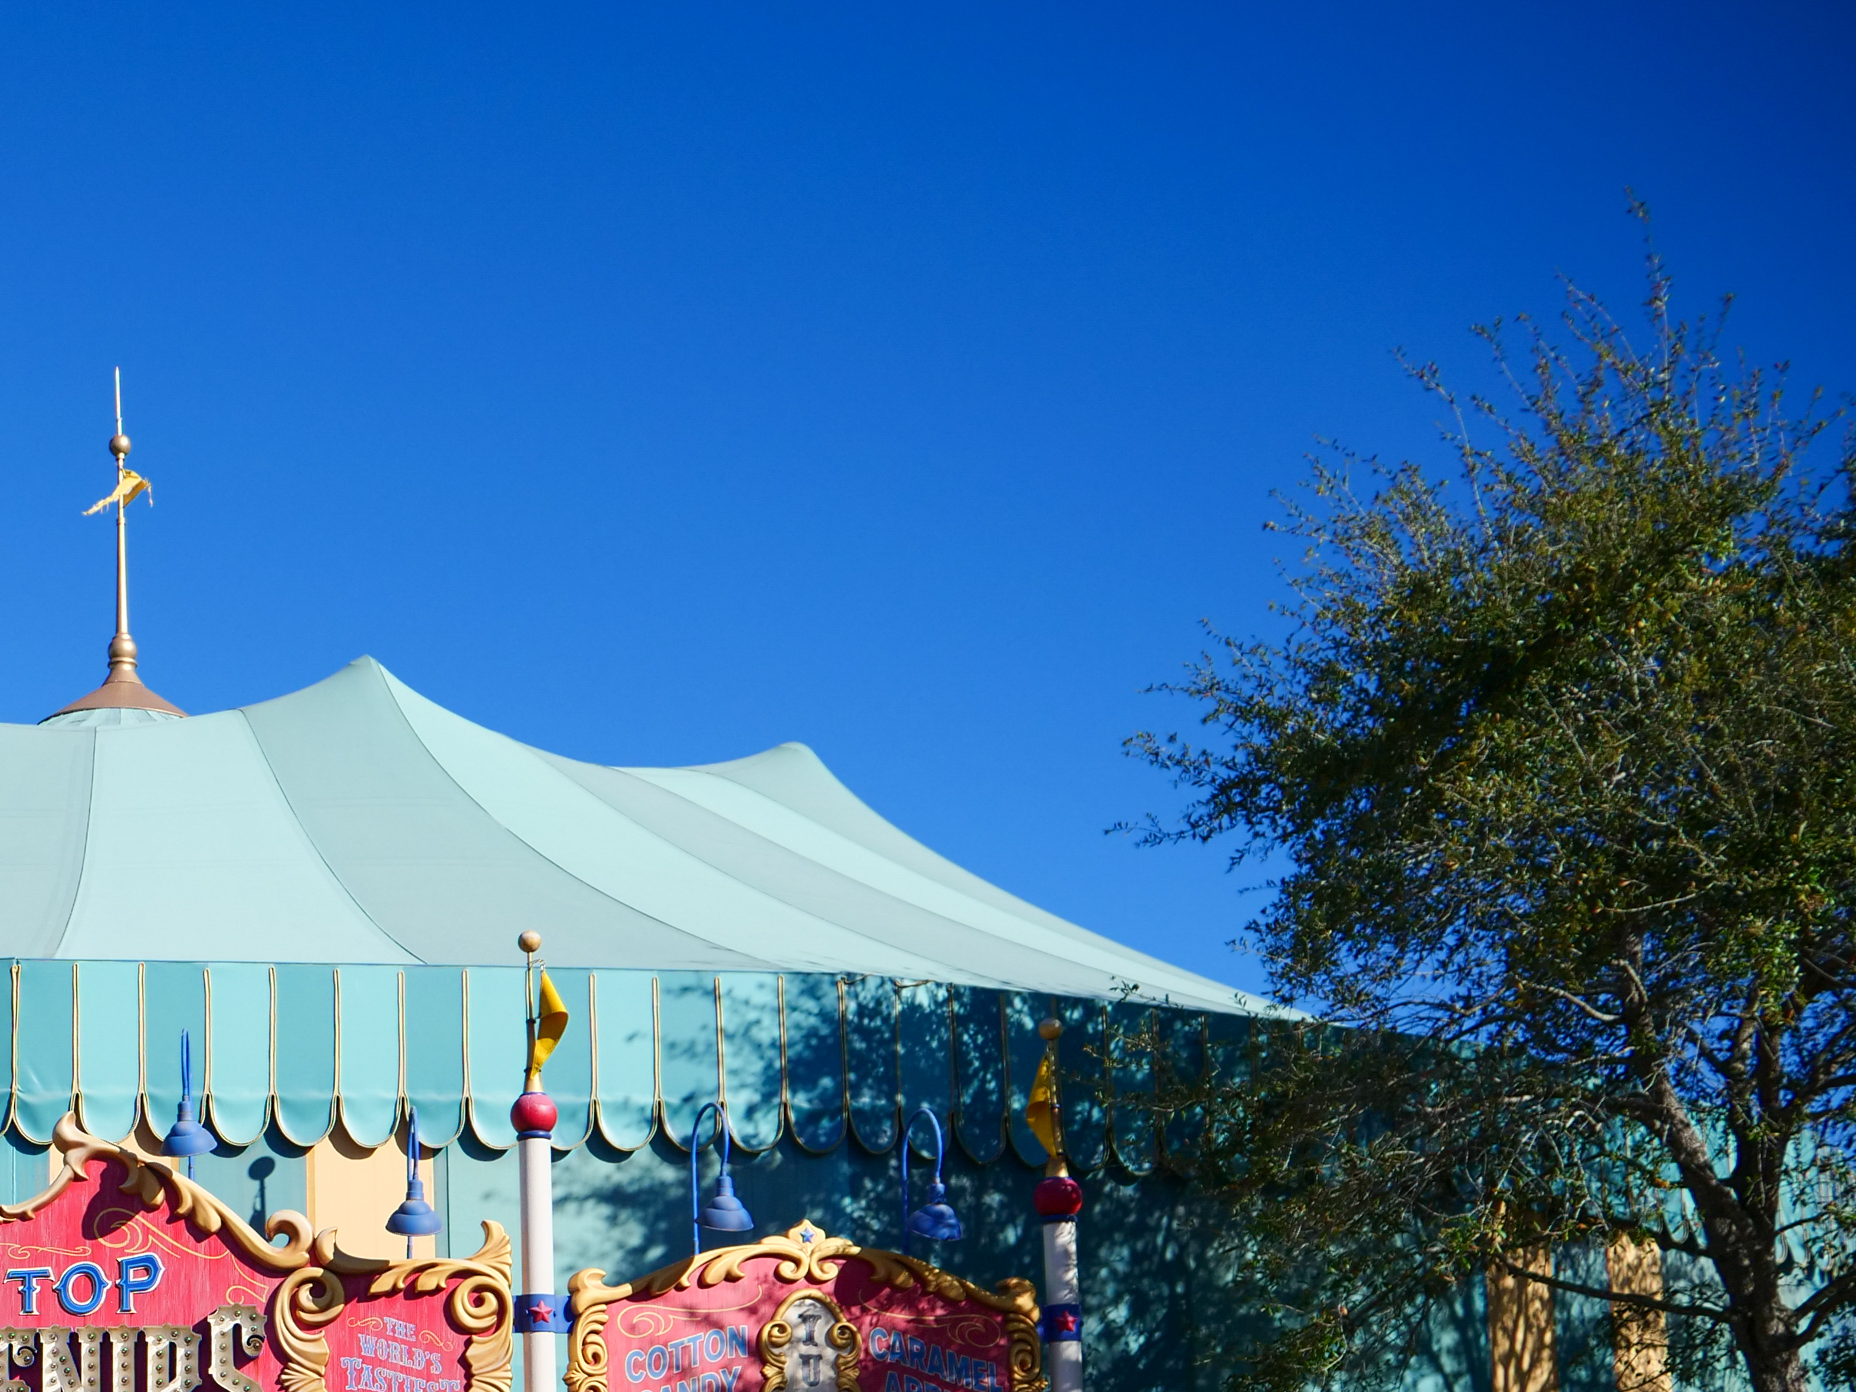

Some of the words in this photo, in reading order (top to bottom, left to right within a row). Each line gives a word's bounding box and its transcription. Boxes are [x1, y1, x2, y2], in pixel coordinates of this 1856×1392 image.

[4, 1252, 167, 1316] TOP
[358, 1333, 443, 1374] WORLD'S
[384, 1317, 416, 1342] THE
[625, 1324, 748, 1384] COTTON
